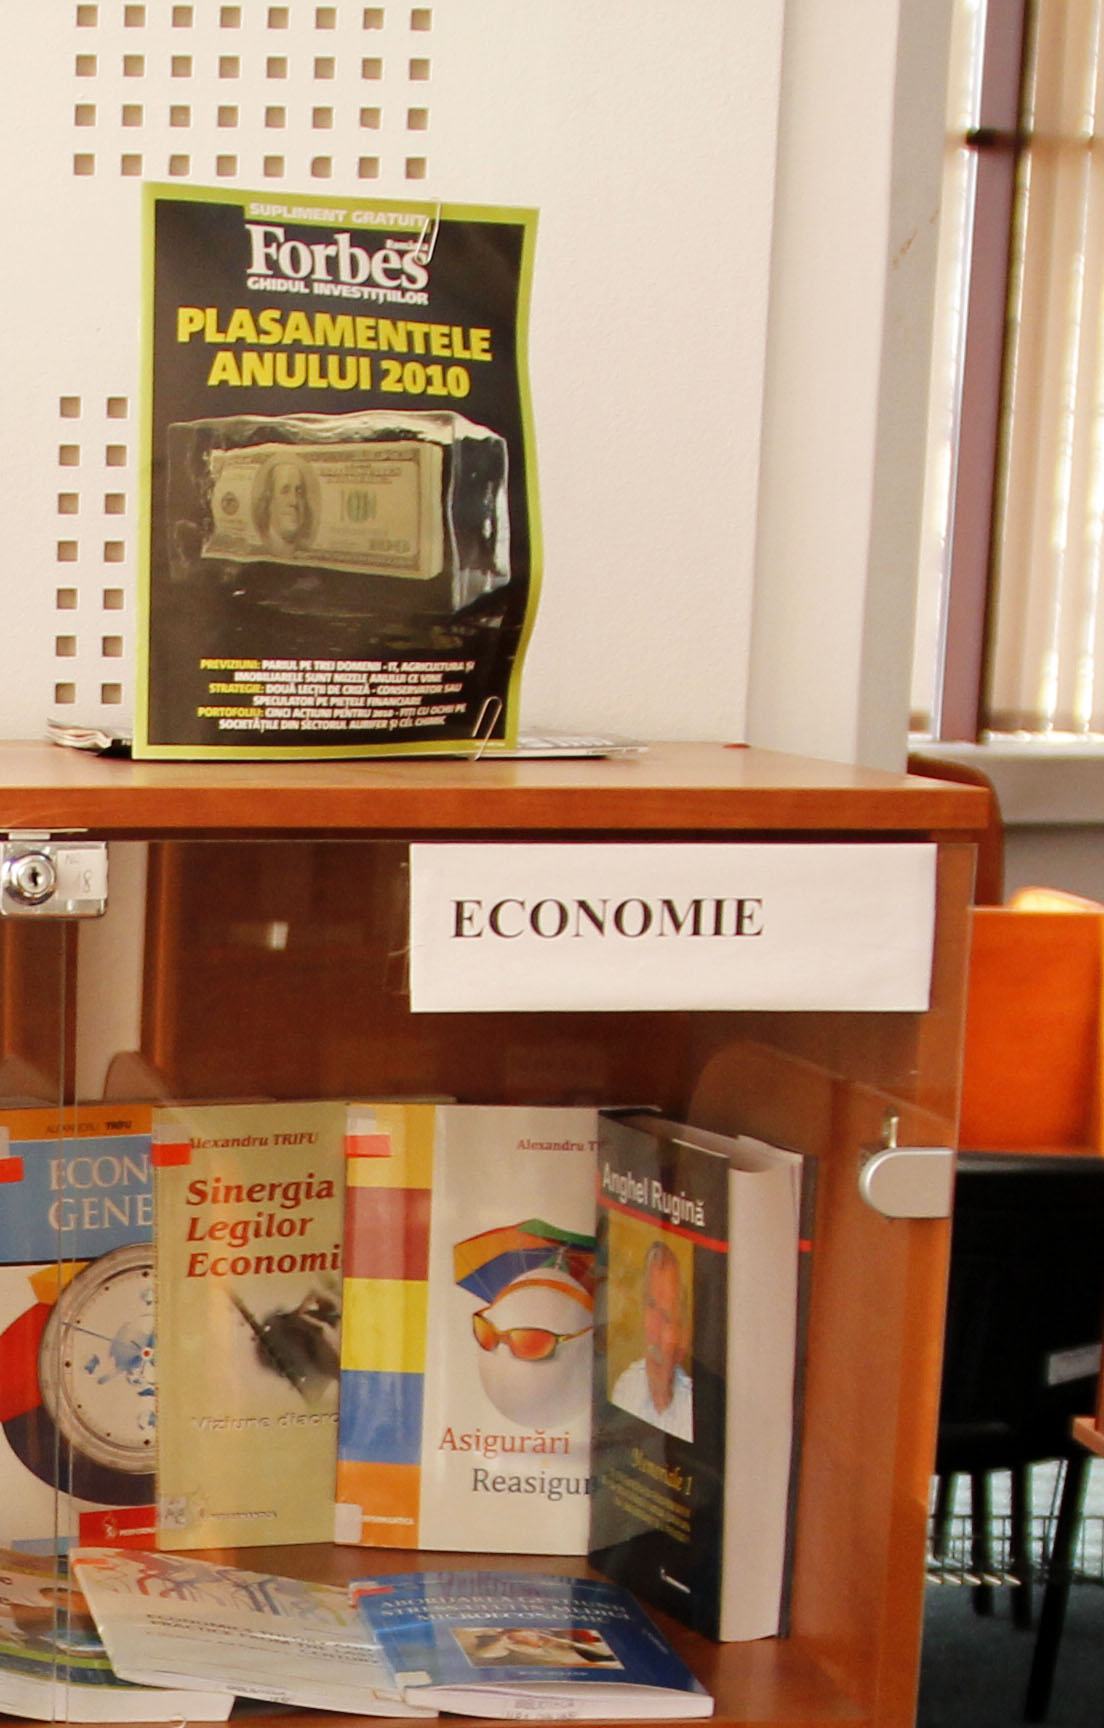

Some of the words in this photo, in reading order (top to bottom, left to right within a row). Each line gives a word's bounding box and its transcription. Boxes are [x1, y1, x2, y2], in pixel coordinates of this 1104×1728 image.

[249, 203, 347, 223] SUPLIMENT
[351, 210, 428, 228] GRATUIT
[245, 223, 430, 291] Forbes
[247, 278, 310, 294] GHIDUL
[177, 306, 493, 362] PLASAMENTELE
[208, 350, 372, 390] ANULUI
[381, 359, 471, 399] 2010
[451, 897, 765, 938] ECONOMIE
[273, 1132, 319, 1145] TRIFU
[516, 1139, 584, 1151] Alexandru
[186, 1173, 335, 1209] Sinergia
[602, 1163, 648, 1203] Anghel
[651, 1180, 706, 1226] Rugină
[186, 1212, 313, 1247] Legilor
[194, 1416, 270, 1431] Viziune
[439, 1427, 570, 1459] Asigurări
